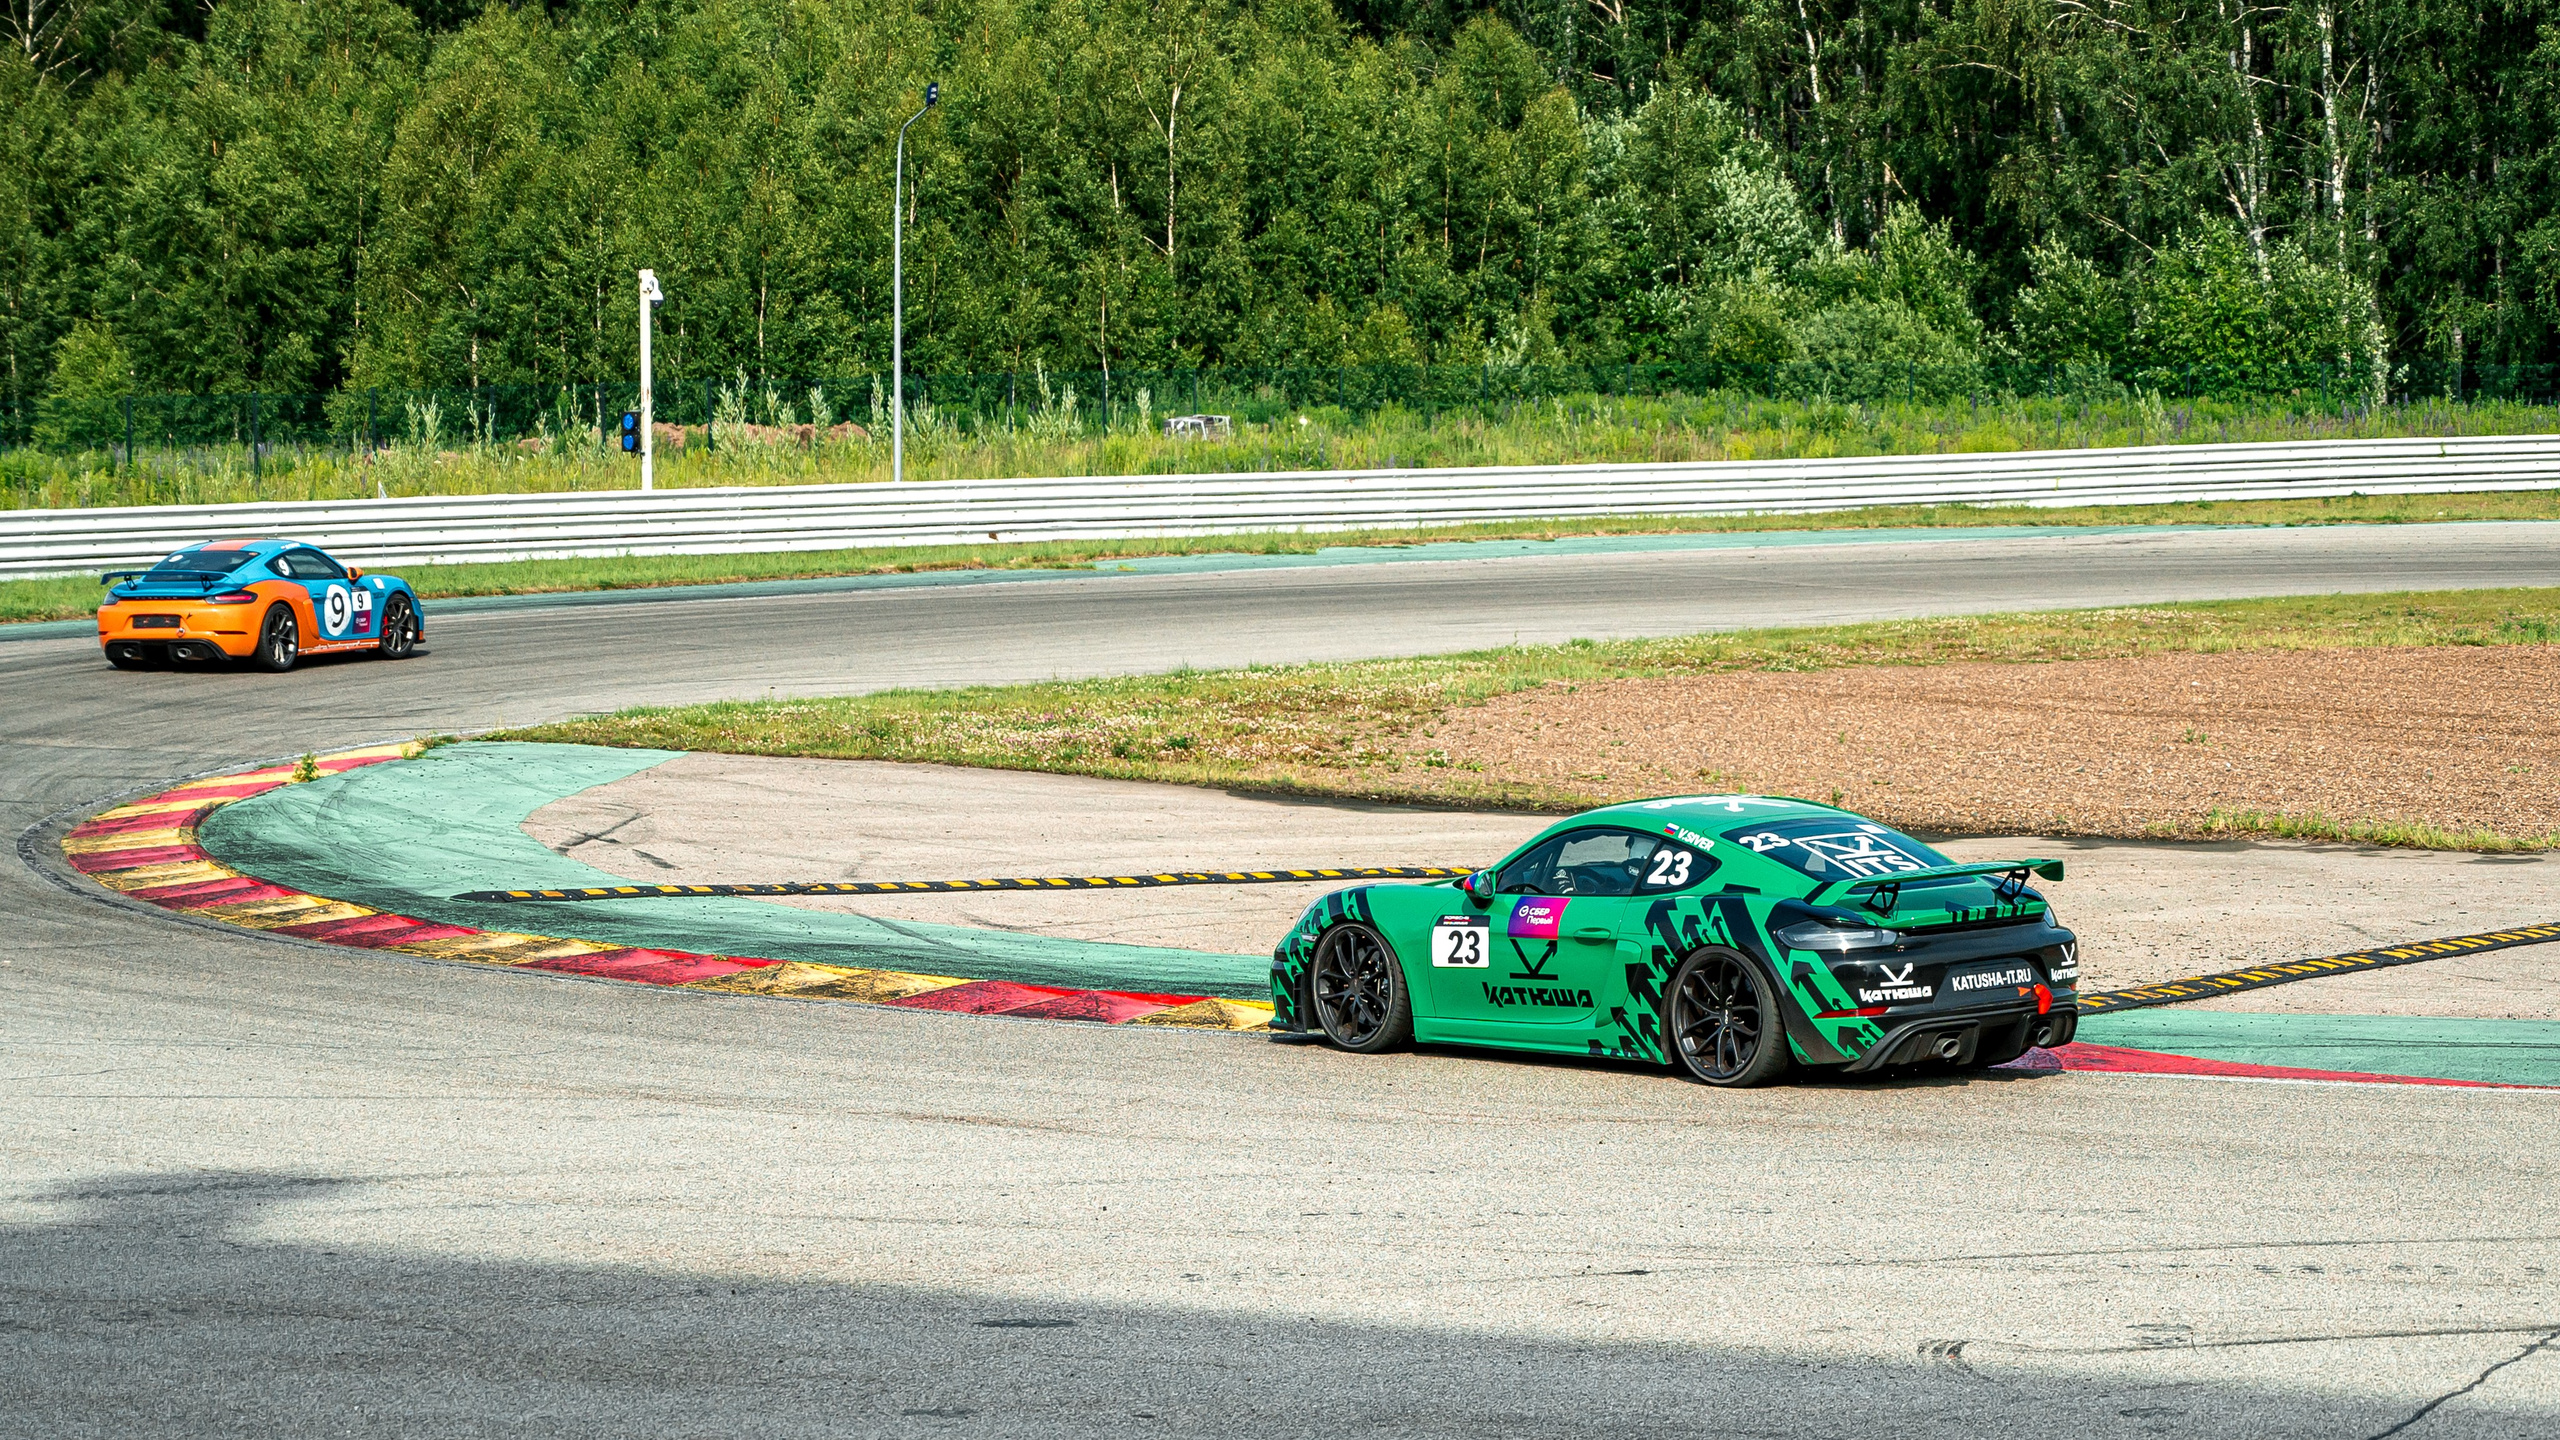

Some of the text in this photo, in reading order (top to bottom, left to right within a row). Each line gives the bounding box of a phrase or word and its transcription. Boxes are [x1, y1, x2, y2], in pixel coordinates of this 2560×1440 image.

[332, 592, 345, 628] 9
[357, 593, 364, 609] 9
[1739, 832, 1793, 853] 23
[1647, 850, 1693, 886] 23
[1844, 855, 1920, 876] ITS
[1448, 930, 1480, 964] 23
[1952, 968, 2032, 991] KATUSHA-IT.RU
